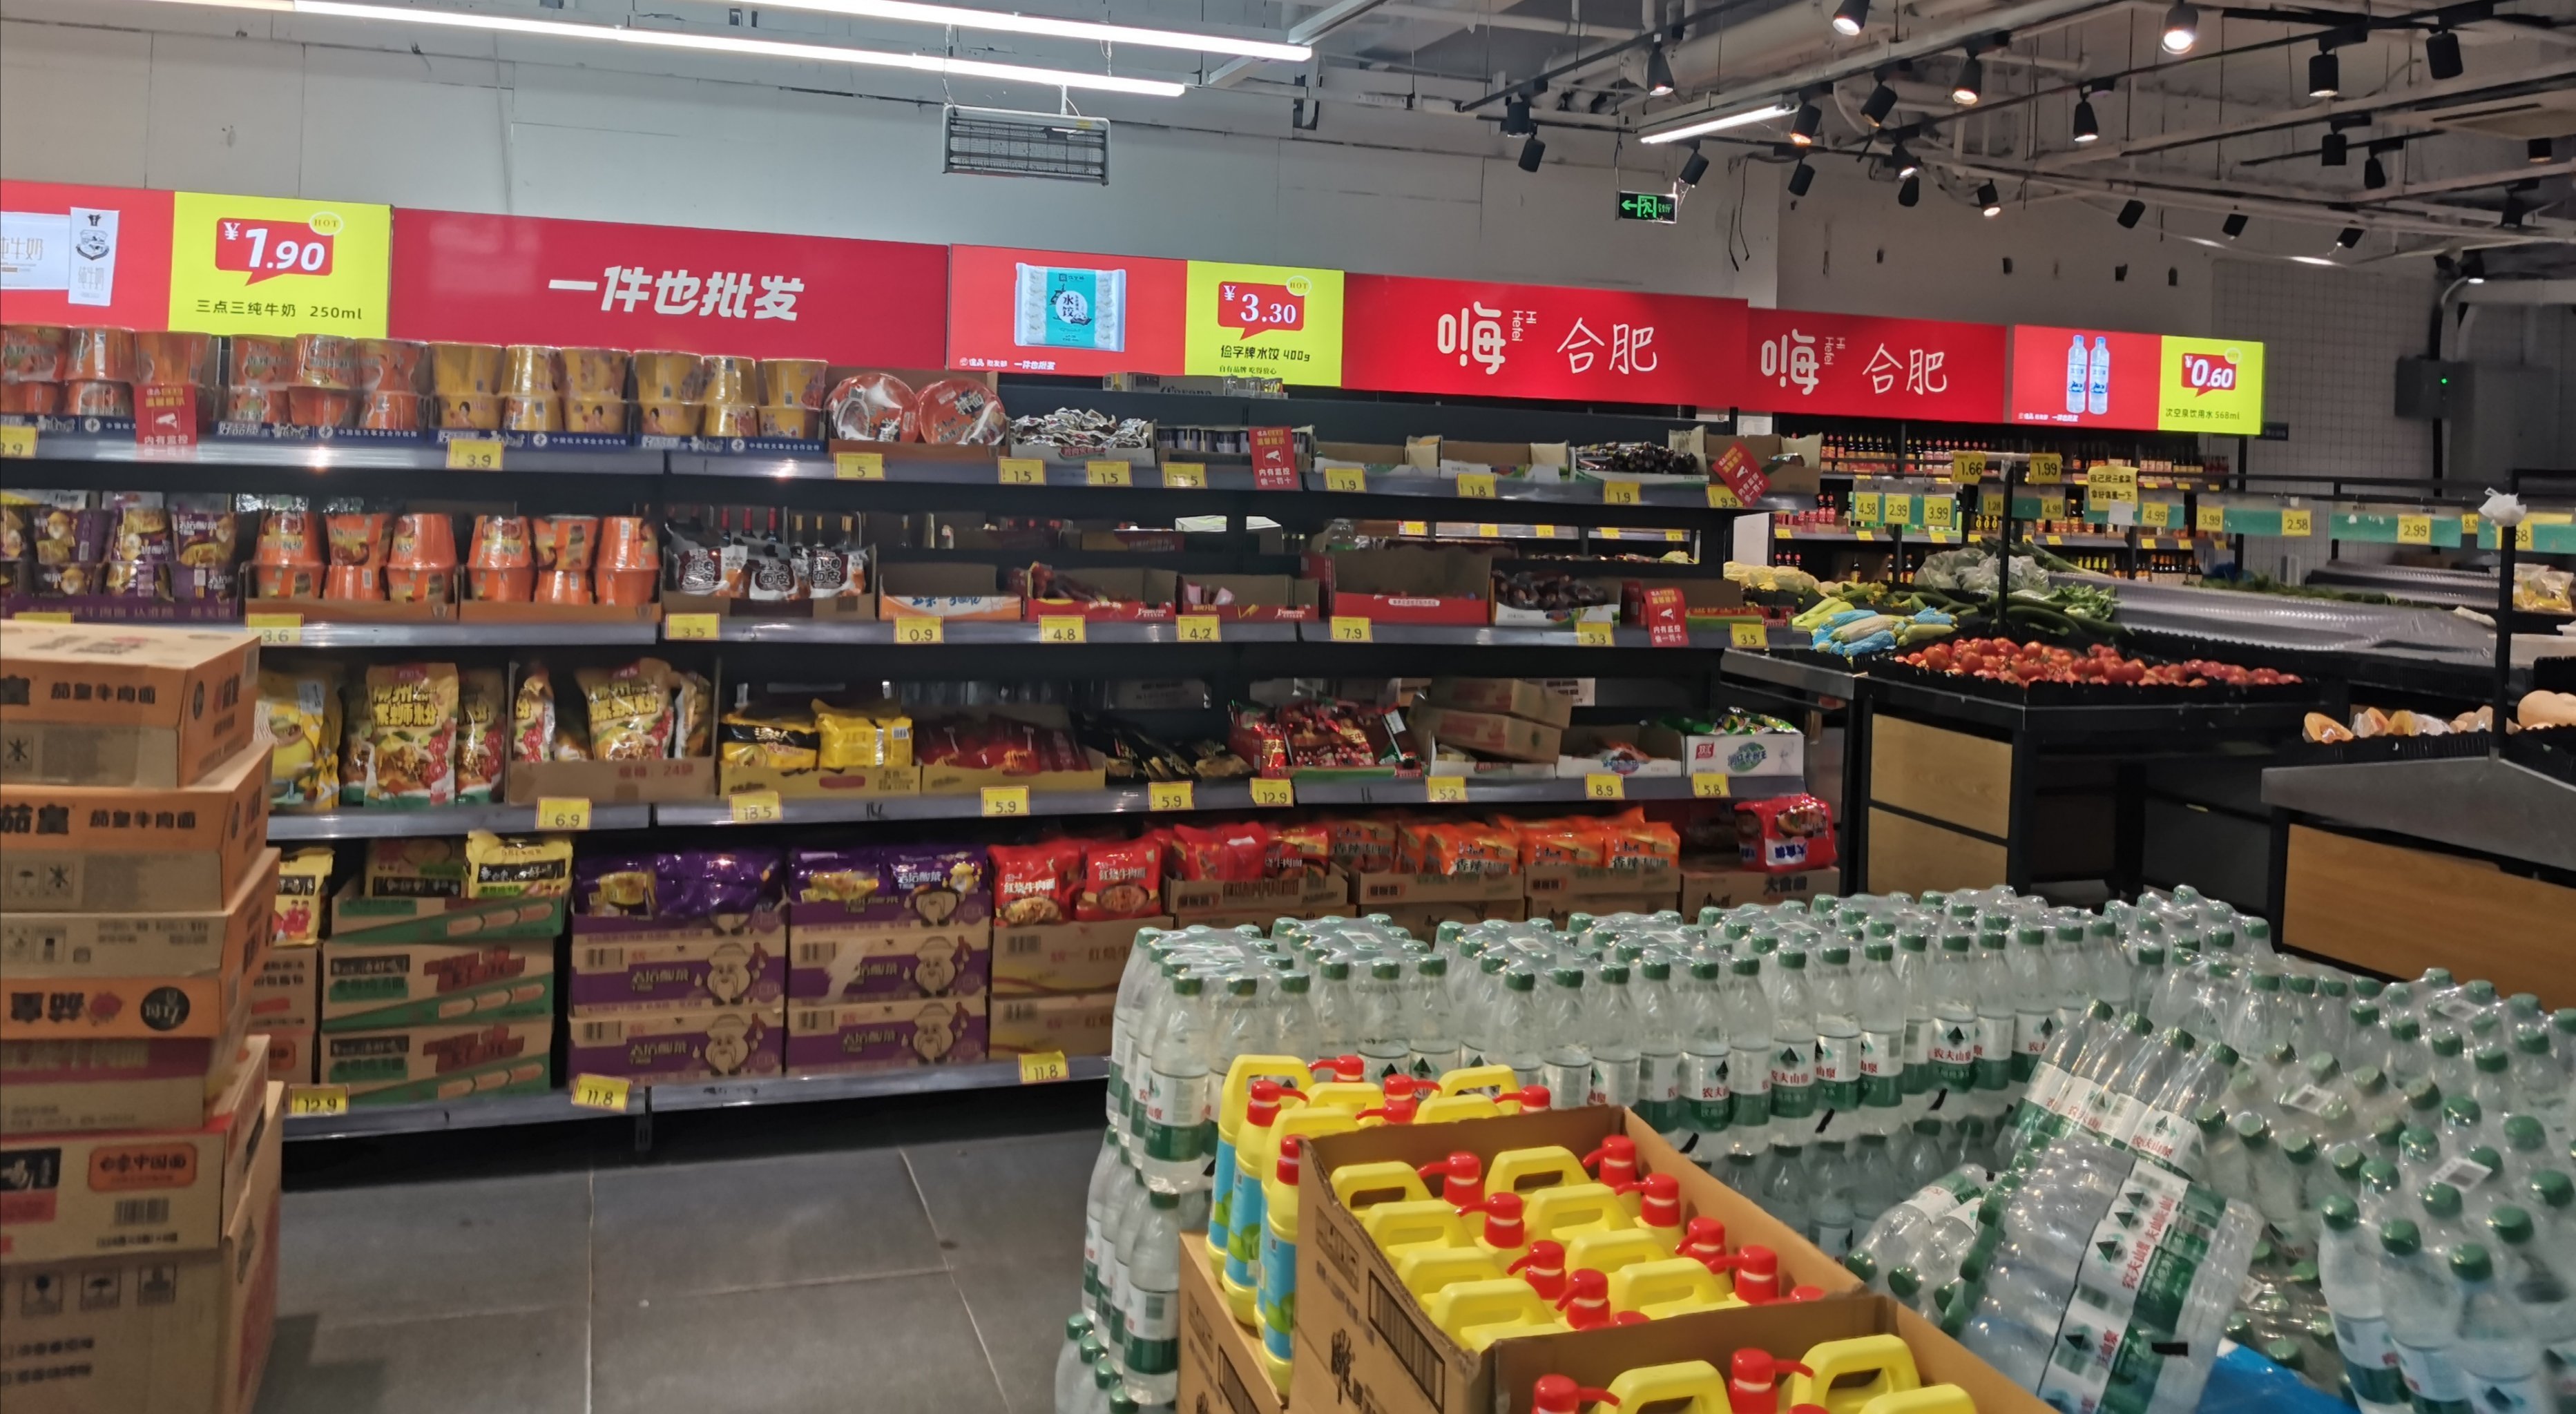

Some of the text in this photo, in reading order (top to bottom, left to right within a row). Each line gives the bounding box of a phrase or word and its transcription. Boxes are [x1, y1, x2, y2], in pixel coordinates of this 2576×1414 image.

[314, 218, 338, 229] HOT
[1290, 282, 1309, 290] HOT
[548, 265, 805, 322] 一件也批发
[195, 300, 363, 320] 三点三纯牛奶 250ml
[1062, 294, 1075, 318] 水饺
[1525, 310, 1537, 325] Hi
[1511, 309, 1524, 342] Hefei
[1437, 301, 1506, 375] 嗨
[1836, 336, 1846, 349] Hi
[1557, 317, 1657, 375] 合肥
[1823, 336, 1834, 365] Hefei
[1282, 349, 1311, 362] 400g
[1760, 329, 1820, 396] 嗨
[1862, 342, 1948, 396] 合肥
[2215, 410, 2240, 420] 568ml
[144, 434, 189, 445] 内有监控
[857, 465, 866, 478] 5
[1258, 467, 1291, 477] 内有监控
[1960, 463, 1983, 476] 1.66
[2036, 463, 2058, 476] 1.99
[1470, 485, 1486, 497] 1.8
[1615, 492, 1631, 503] 1.9
[1858, 502, 1876, 516] 4.58
[1889, 503, 1908, 517] 2.99
[1927, 505, 1949, 520] 3.99
[2044, 503, 2062, 516] 4.99
[2146, 510, 2166, 523] 4.99
[2200, 513, 2221, 526] 3.99
[2287, 517, 2309, 531] 2.58
[2403, 523, 2428, 538] 2.99
[909, 628, 934, 641] 0.9
[1053, 628, 1076, 641] 4.8
[1189, 628, 1211, 640] 4.2
[1343, 628, 1363, 639] 7.9
[1439, 788, 1457, 801] 5.2
[1595, 784, 1613, 797] 8.9
[1704, 784, 1721, 796] 5.8
[1161, 795, 1182, 808] 5.9
[1262, 791, 1287, 804] 12.9
[995, 801, 1017, 814] 5.9
[555, 813, 581, 827] 6.9
[1098, 867, 1146, 882] 红烧牛肉面
[1003, 878, 1056, 895] 红烧牛肉面
[1032, 1064, 1059, 1080] 11.8
[586, 1089, 614, 1106] 11.8
